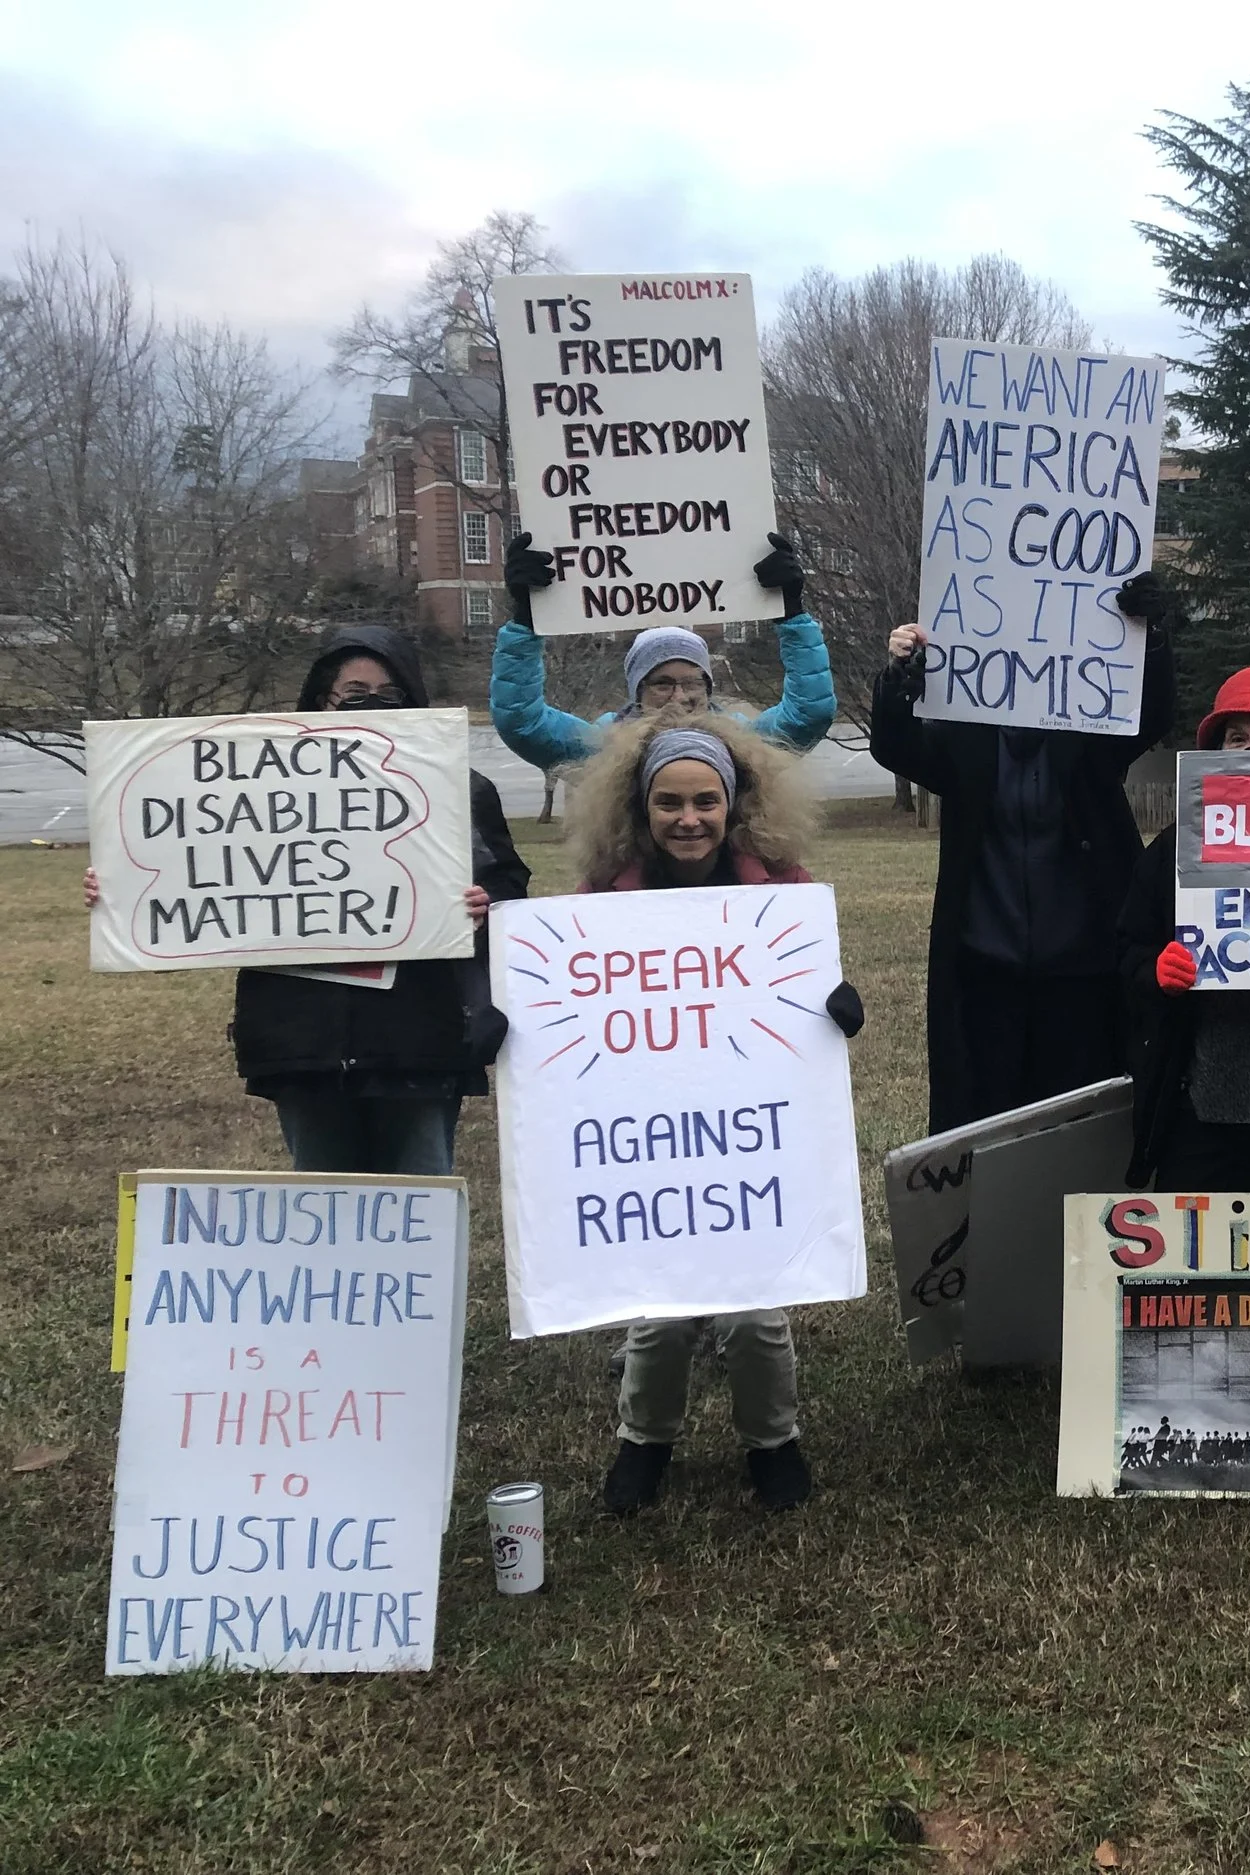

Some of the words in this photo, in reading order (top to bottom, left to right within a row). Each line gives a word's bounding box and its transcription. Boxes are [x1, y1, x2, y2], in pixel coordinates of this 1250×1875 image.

[524, 293, 592, 335] IT'S
[621, 279, 712, 301] MALCOLM
[558, 337, 723, 375] FREEDOM
[533, 382, 604, 417] FOR
[933, 346, 996, 410] WE
[1001, 351, 1108, 420] WANT
[1105, 366, 1159, 425] AN
[562, 418, 750, 458] EVERYBODY
[926, 417, 1150, 506] AMERICA
[541, 464, 592, 498] OR
[568, 500, 731, 539] FREEDOM
[927, 495, 993, 564] AS
[1007, 502, 1142, 577] GOOD
[553, 545, 633, 582] FOR
[582, 580, 726, 619] NOBODY.
[932, 573, 1003, 639] AS
[1027, 578, 1127, 652] ITS
[920, 642, 1134, 724] PROMISE
[1039, 717, 1072, 728] Barbara
[192, 738, 368, 783] BLACK
[142, 787, 410, 839] DISABLED
[186, 839, 351, 890] LIVES
[149, 886, 400, 945] MATTER!
[568, 944, 751, 998] SPEAK
[604, 1003, 716, 1055] OUT
[573, 1101, 789, 1169] AGAINST
[161, 1186, 432, 1247] INJUSTICE
[576, 1176, 782, 1247] RACISM
[145, 1265, 434, 1327] ANYWHERE
[1123, 1278, 1144, 1286] Martin
[1144, 1278, 1165, 1286] Luther
[1123, 1295, 1132, 1327] I
[1140, 1295, 1208, 1327] HAVE
[1213, 1295, 1232, 1327] A
[229, 1347, 264, 1371] IS
[300, 1348, 322, 1369] A
[171, 1389, 406, 1449] THREAT
[249, 1472, 309, 1497] TO
[132, 1515, 396, 1580] JUSTICE
[117, 1590, 423, 1665] EVERYWHERE
